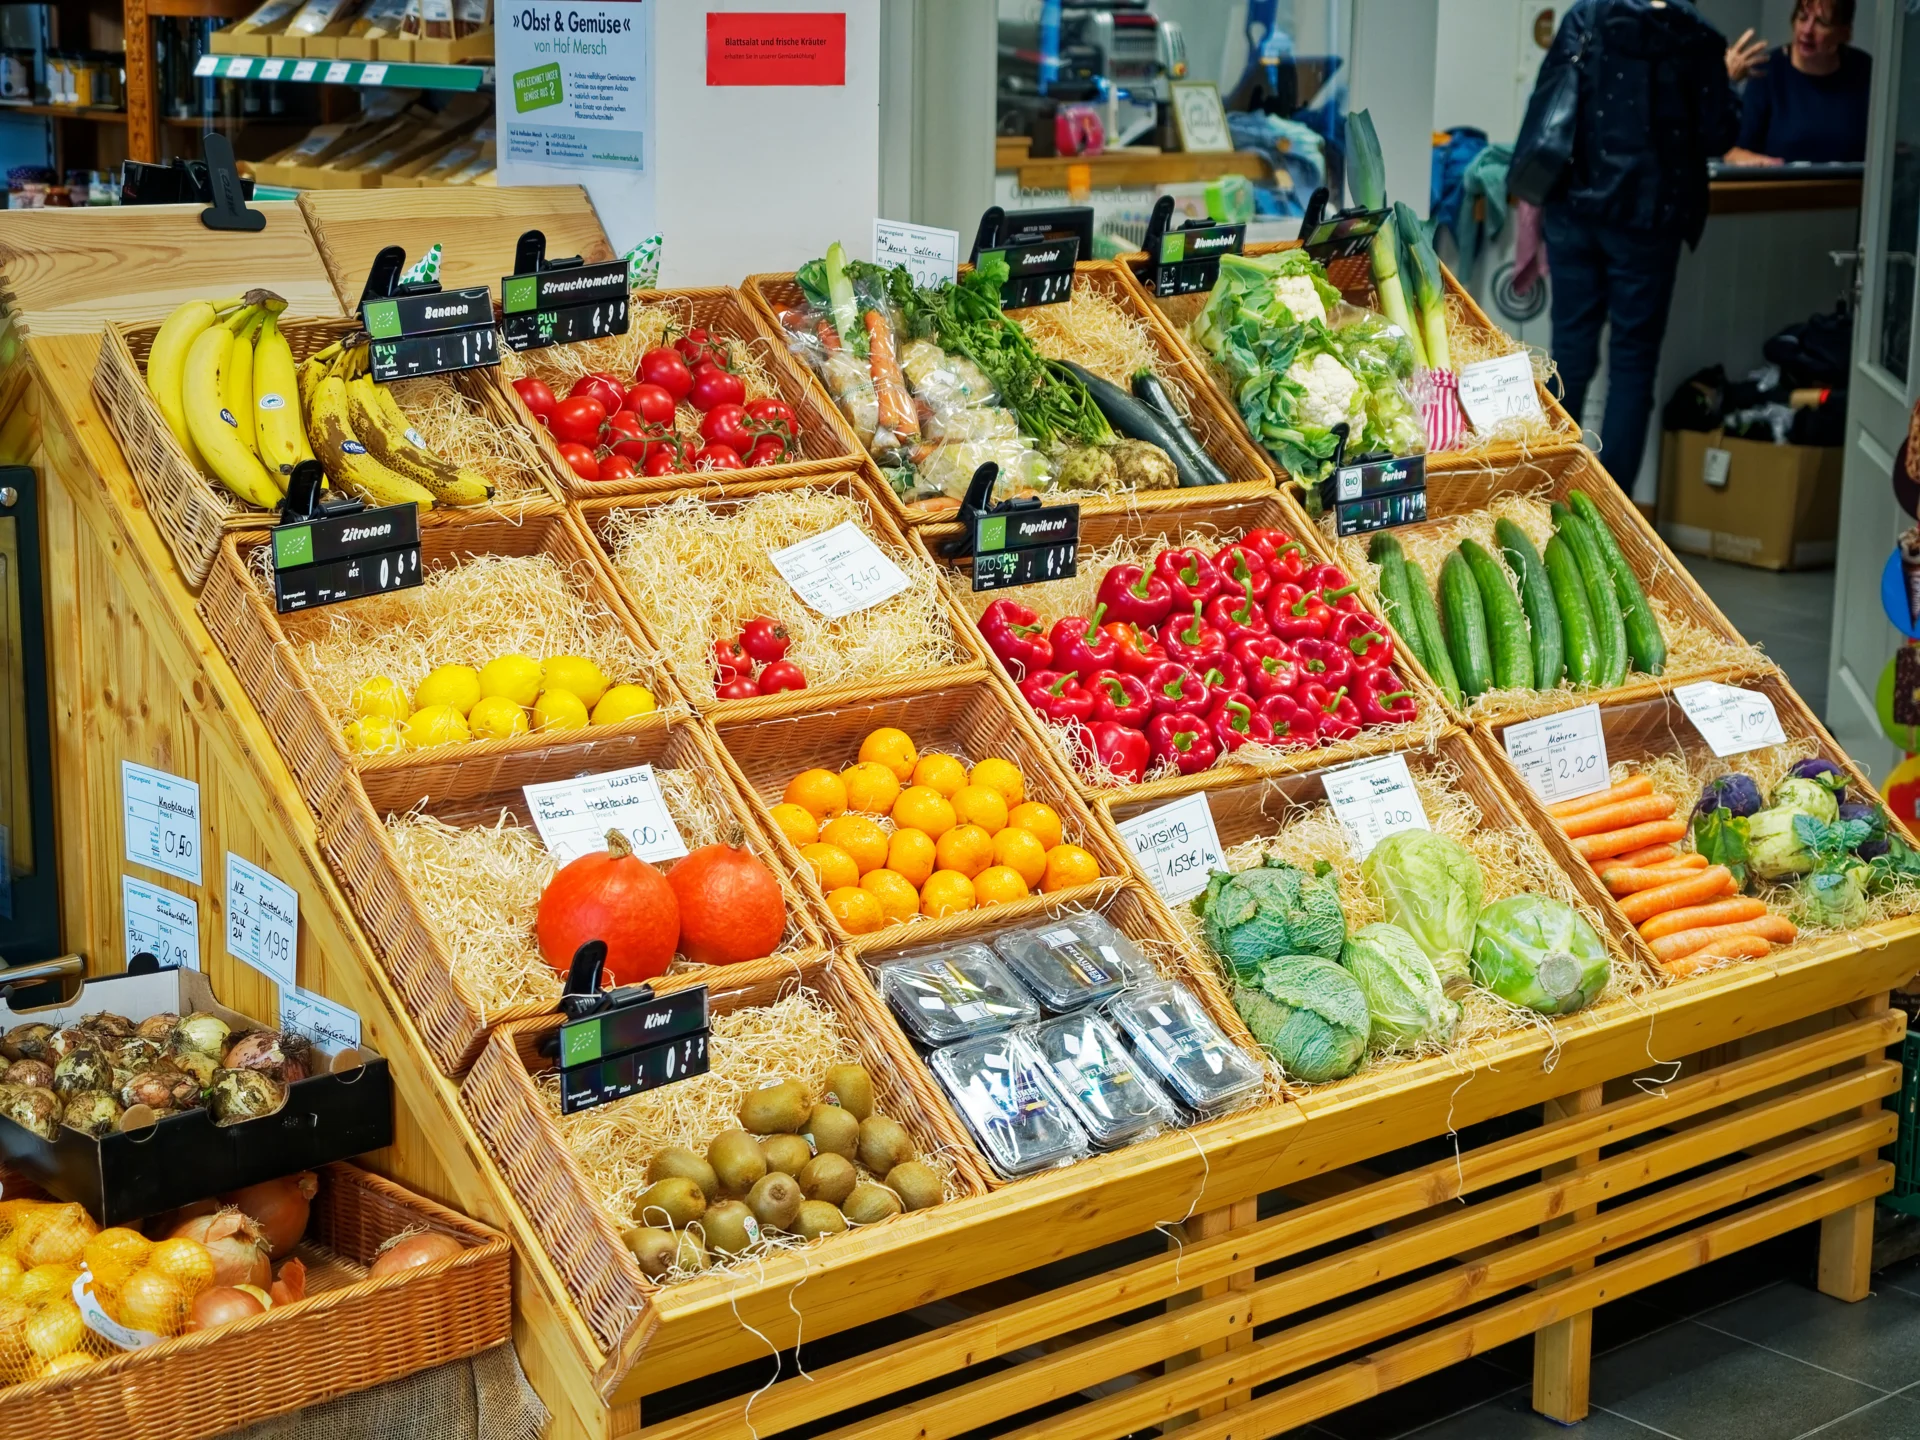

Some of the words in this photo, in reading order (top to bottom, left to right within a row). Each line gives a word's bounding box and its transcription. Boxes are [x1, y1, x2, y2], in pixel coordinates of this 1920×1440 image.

[554, 11, 564, 32] &
[534, 42, 551, 53] von
[554, 37, 570, 53] Hof
[573, 39, 607, 55] Mersch
[725, 38, 759, 47] Blattsalat
[761, 38, 774, 46] und
[776, 37, 799, 46] frische
[801, 38, 827, 46] Kräuter
[878, 236, 888, 246] Hof
[914, 246, 942, 259] Sellerie
[1194, 234, 1236, 249] Blumenkohl
[1022, 250, 1060, 265] Zucchini
[541, 272, 625, 295] Strauchtomaten
[424, 304, 469, 319] Bananen
[537, 312, 558, 325] PLU
[374, 344, 397, 358] PLU
[462, 330, 493, 364] 1.99
[1345, 477, 1358, 487] BIO
[1381, 469, 1408, 483] Gurken
[341, 522, 392, 543] Zitronen
[1019, 519, 1052, 536] Paprika
[1052, 517, 1067, 530] rot
[1003, 553, 1019, 563] PLU
[379, 550, 417, 589] 0.69
[1003, 563, 1017, 574] 17
[845, 565, 881, 592] 3,40
[1547, 732, 1578, 746] Möhren
[1558, 754, 1598, 779] 2,20
[608, 773, 649, 788] Kürbis
[158, 795, 194, 818] Knoblauch
[537, 797, 555, 808] Hof
[584, 794, 640, 811] Hokkaido
[539, 808, 575, 820] Mersch
[1135, 821, 1189, 853] Wirsing
[1156, 845, 1170, 854] Preis
[231, 911, 246, 929] PLU
[129, 929, 144, 942] PLU
[232, 927, 243, 942] 24
[264, 929, 289, 960] 1,98
[1065, 945, 1106, 981] PFLAUMEN
[644, 1009, 673, 1029] Kiwi
